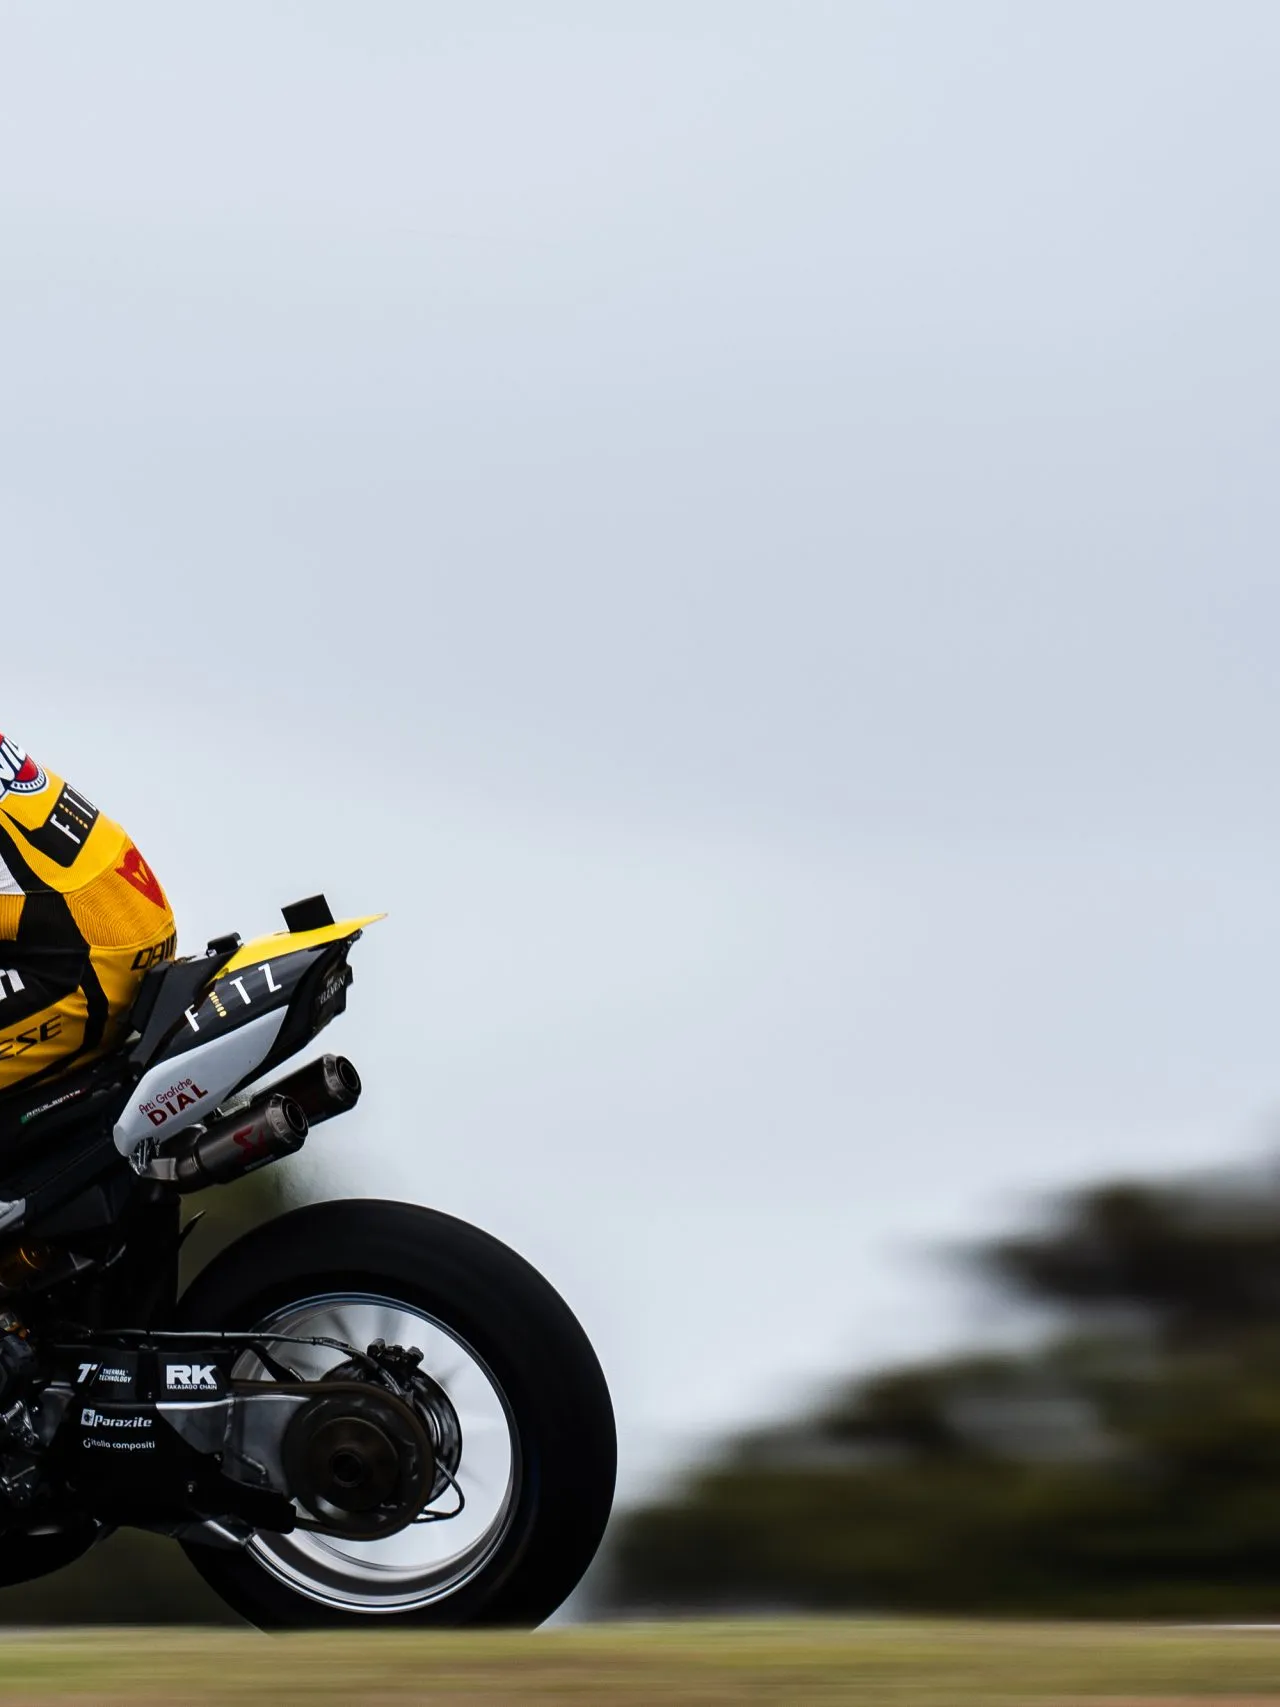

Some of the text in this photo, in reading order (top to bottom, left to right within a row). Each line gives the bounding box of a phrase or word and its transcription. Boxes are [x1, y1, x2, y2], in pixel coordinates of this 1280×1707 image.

[155, 1077, 193, 1104] Grafiche
[147, 1083, 209, 1126] DIAL
[166, 1364, 217, 1385] RK
